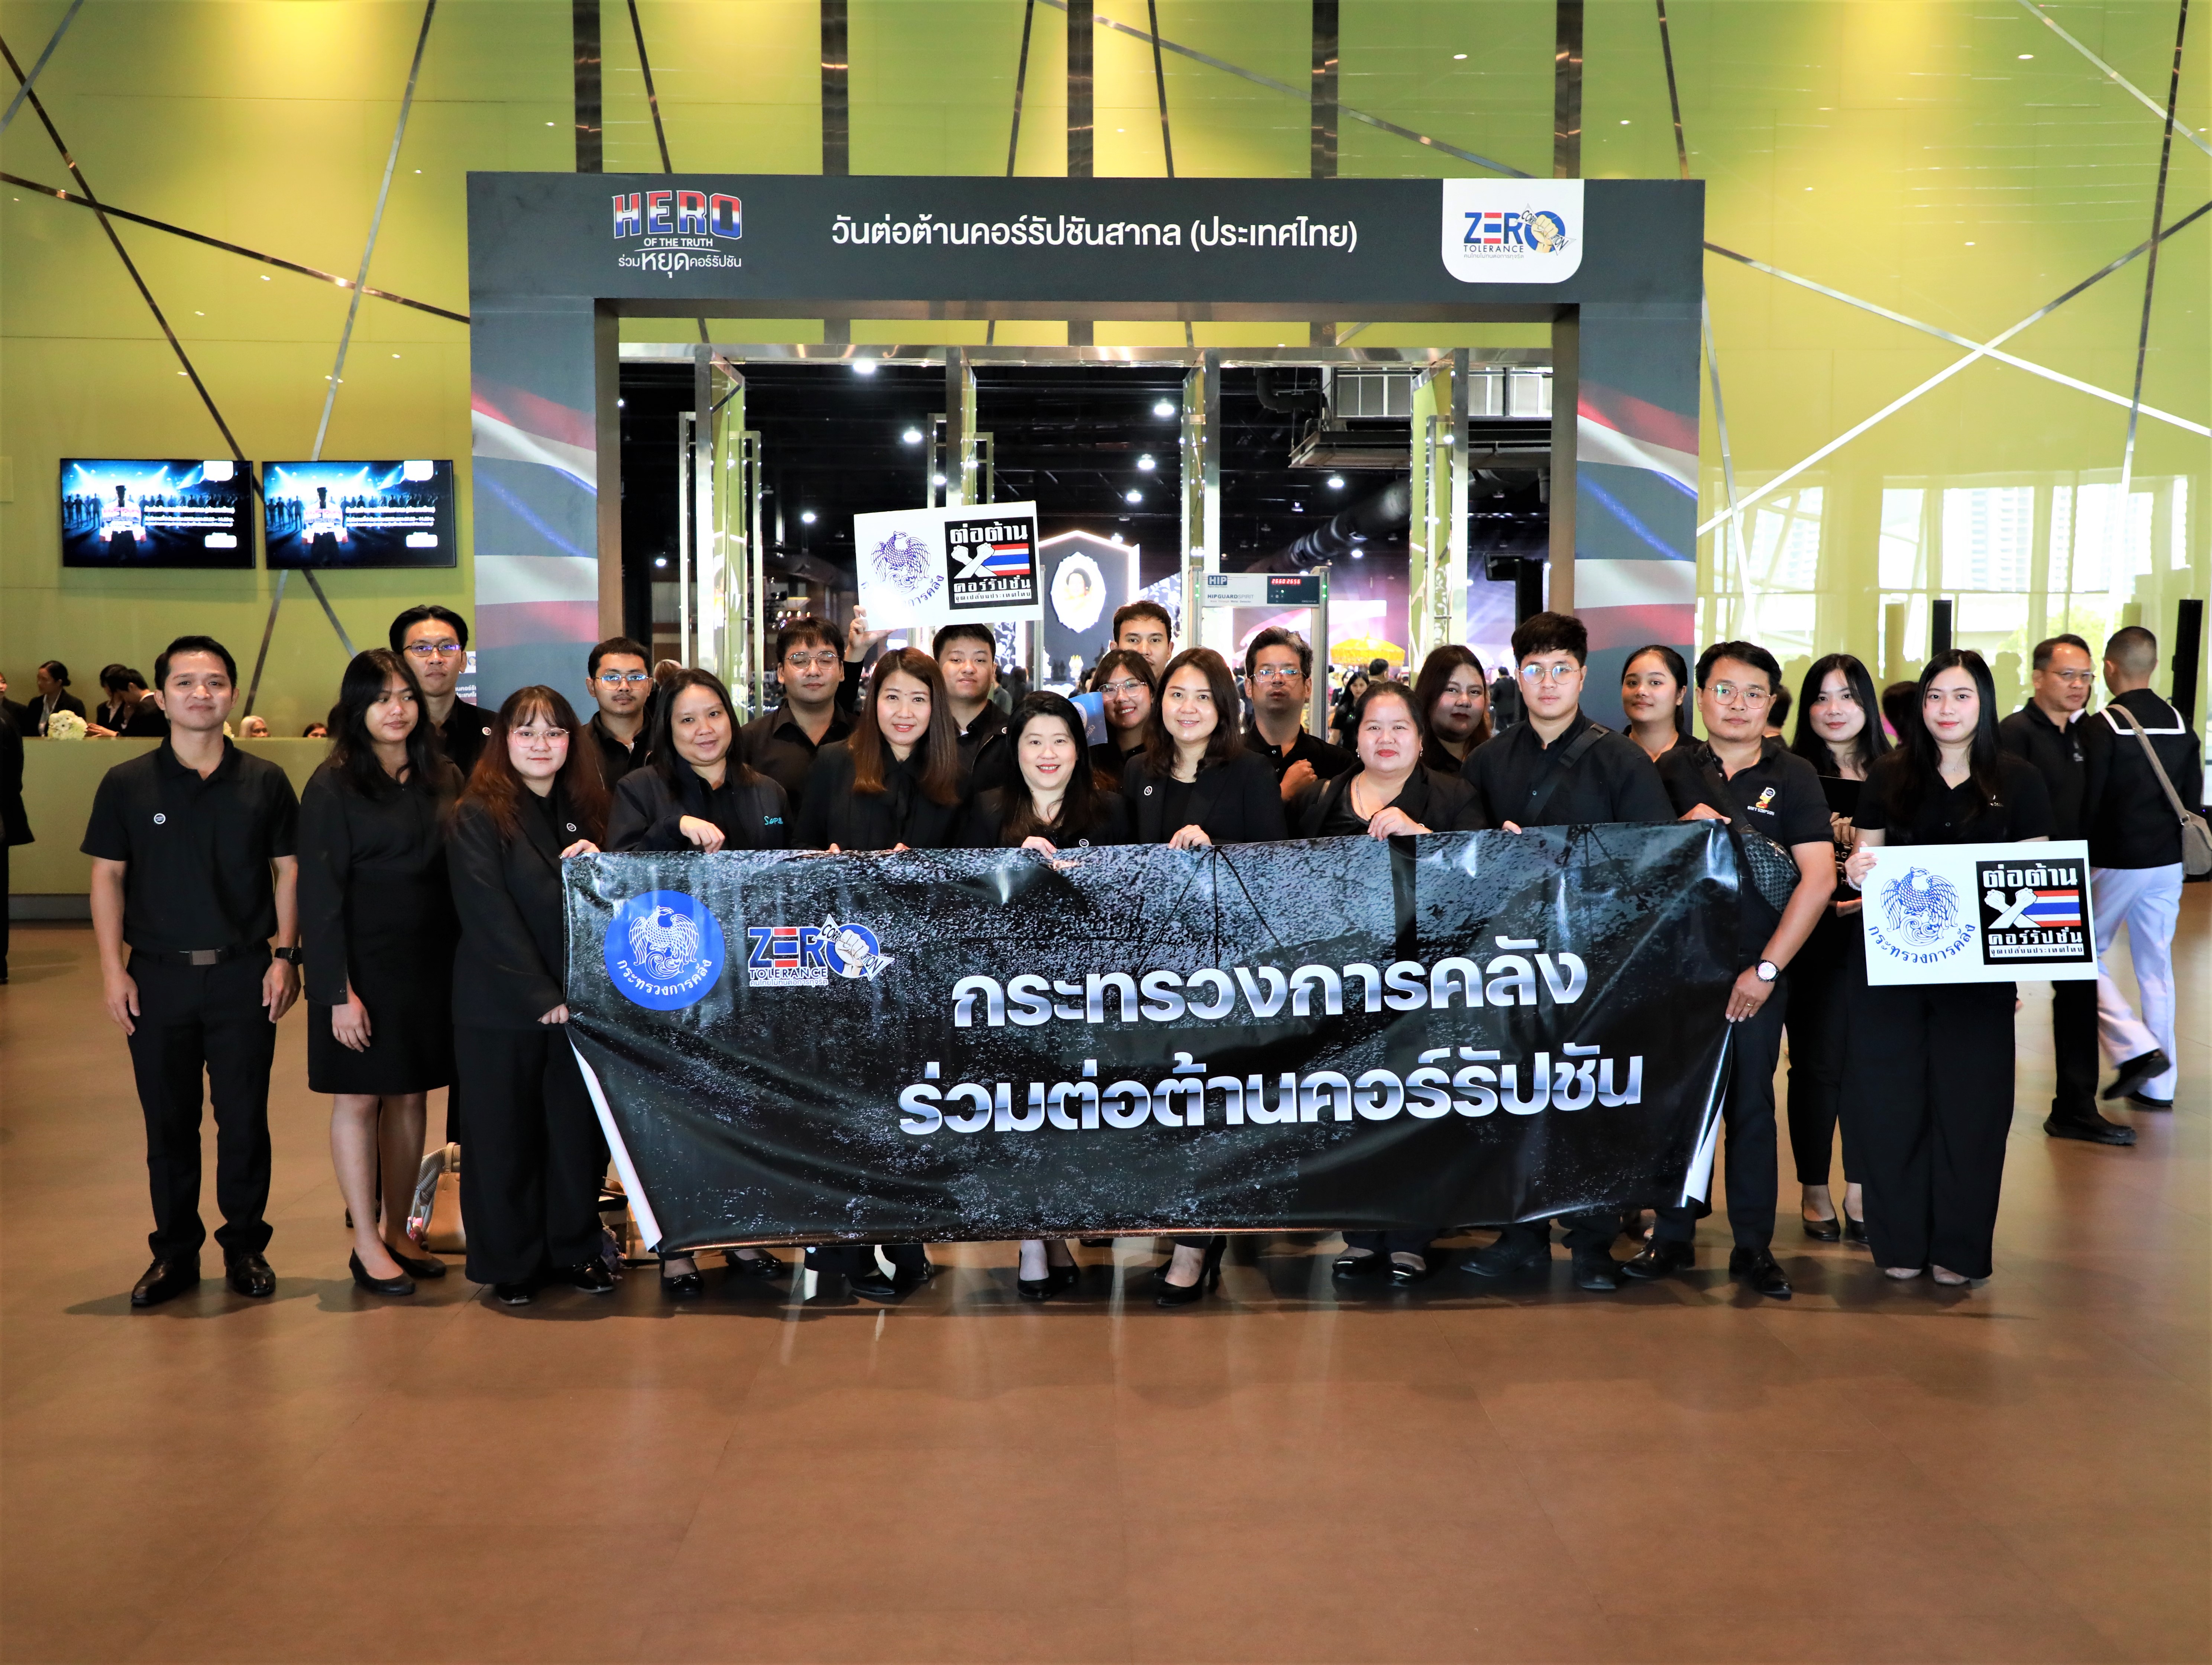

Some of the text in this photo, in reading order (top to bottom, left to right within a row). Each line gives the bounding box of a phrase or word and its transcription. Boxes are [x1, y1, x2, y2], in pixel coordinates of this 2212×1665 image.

[612, 190, 742, 240] HERO
[831, 214, 1357, 253] วันต่อต้านคอร์รัปชันสากล (ประเทศไทย)
[1464, 210, 1565, 253] ZERO
[644, 238, 713, 247] OF THE TRUTH
[950, 521, 1028, 544] ต่อต้าน
[1209, 576, 1227, 585] HIP
[1983, 863, 2077, 888] ต่อต้าน
[748, 923, 880, 978] ZERO
[1868, 924, 1975, 963] กระทรวงการคลัง
[617, 959, 713, 996] กระทรวงการคลัง
[749, 969, 828, 979] TOLERANCE
[951, 935, 1589, 1028] กระทรวงการคลัง
[897, 1043, 1644, 1135] ร่วมต่อต้านคอร์รัปชัน
